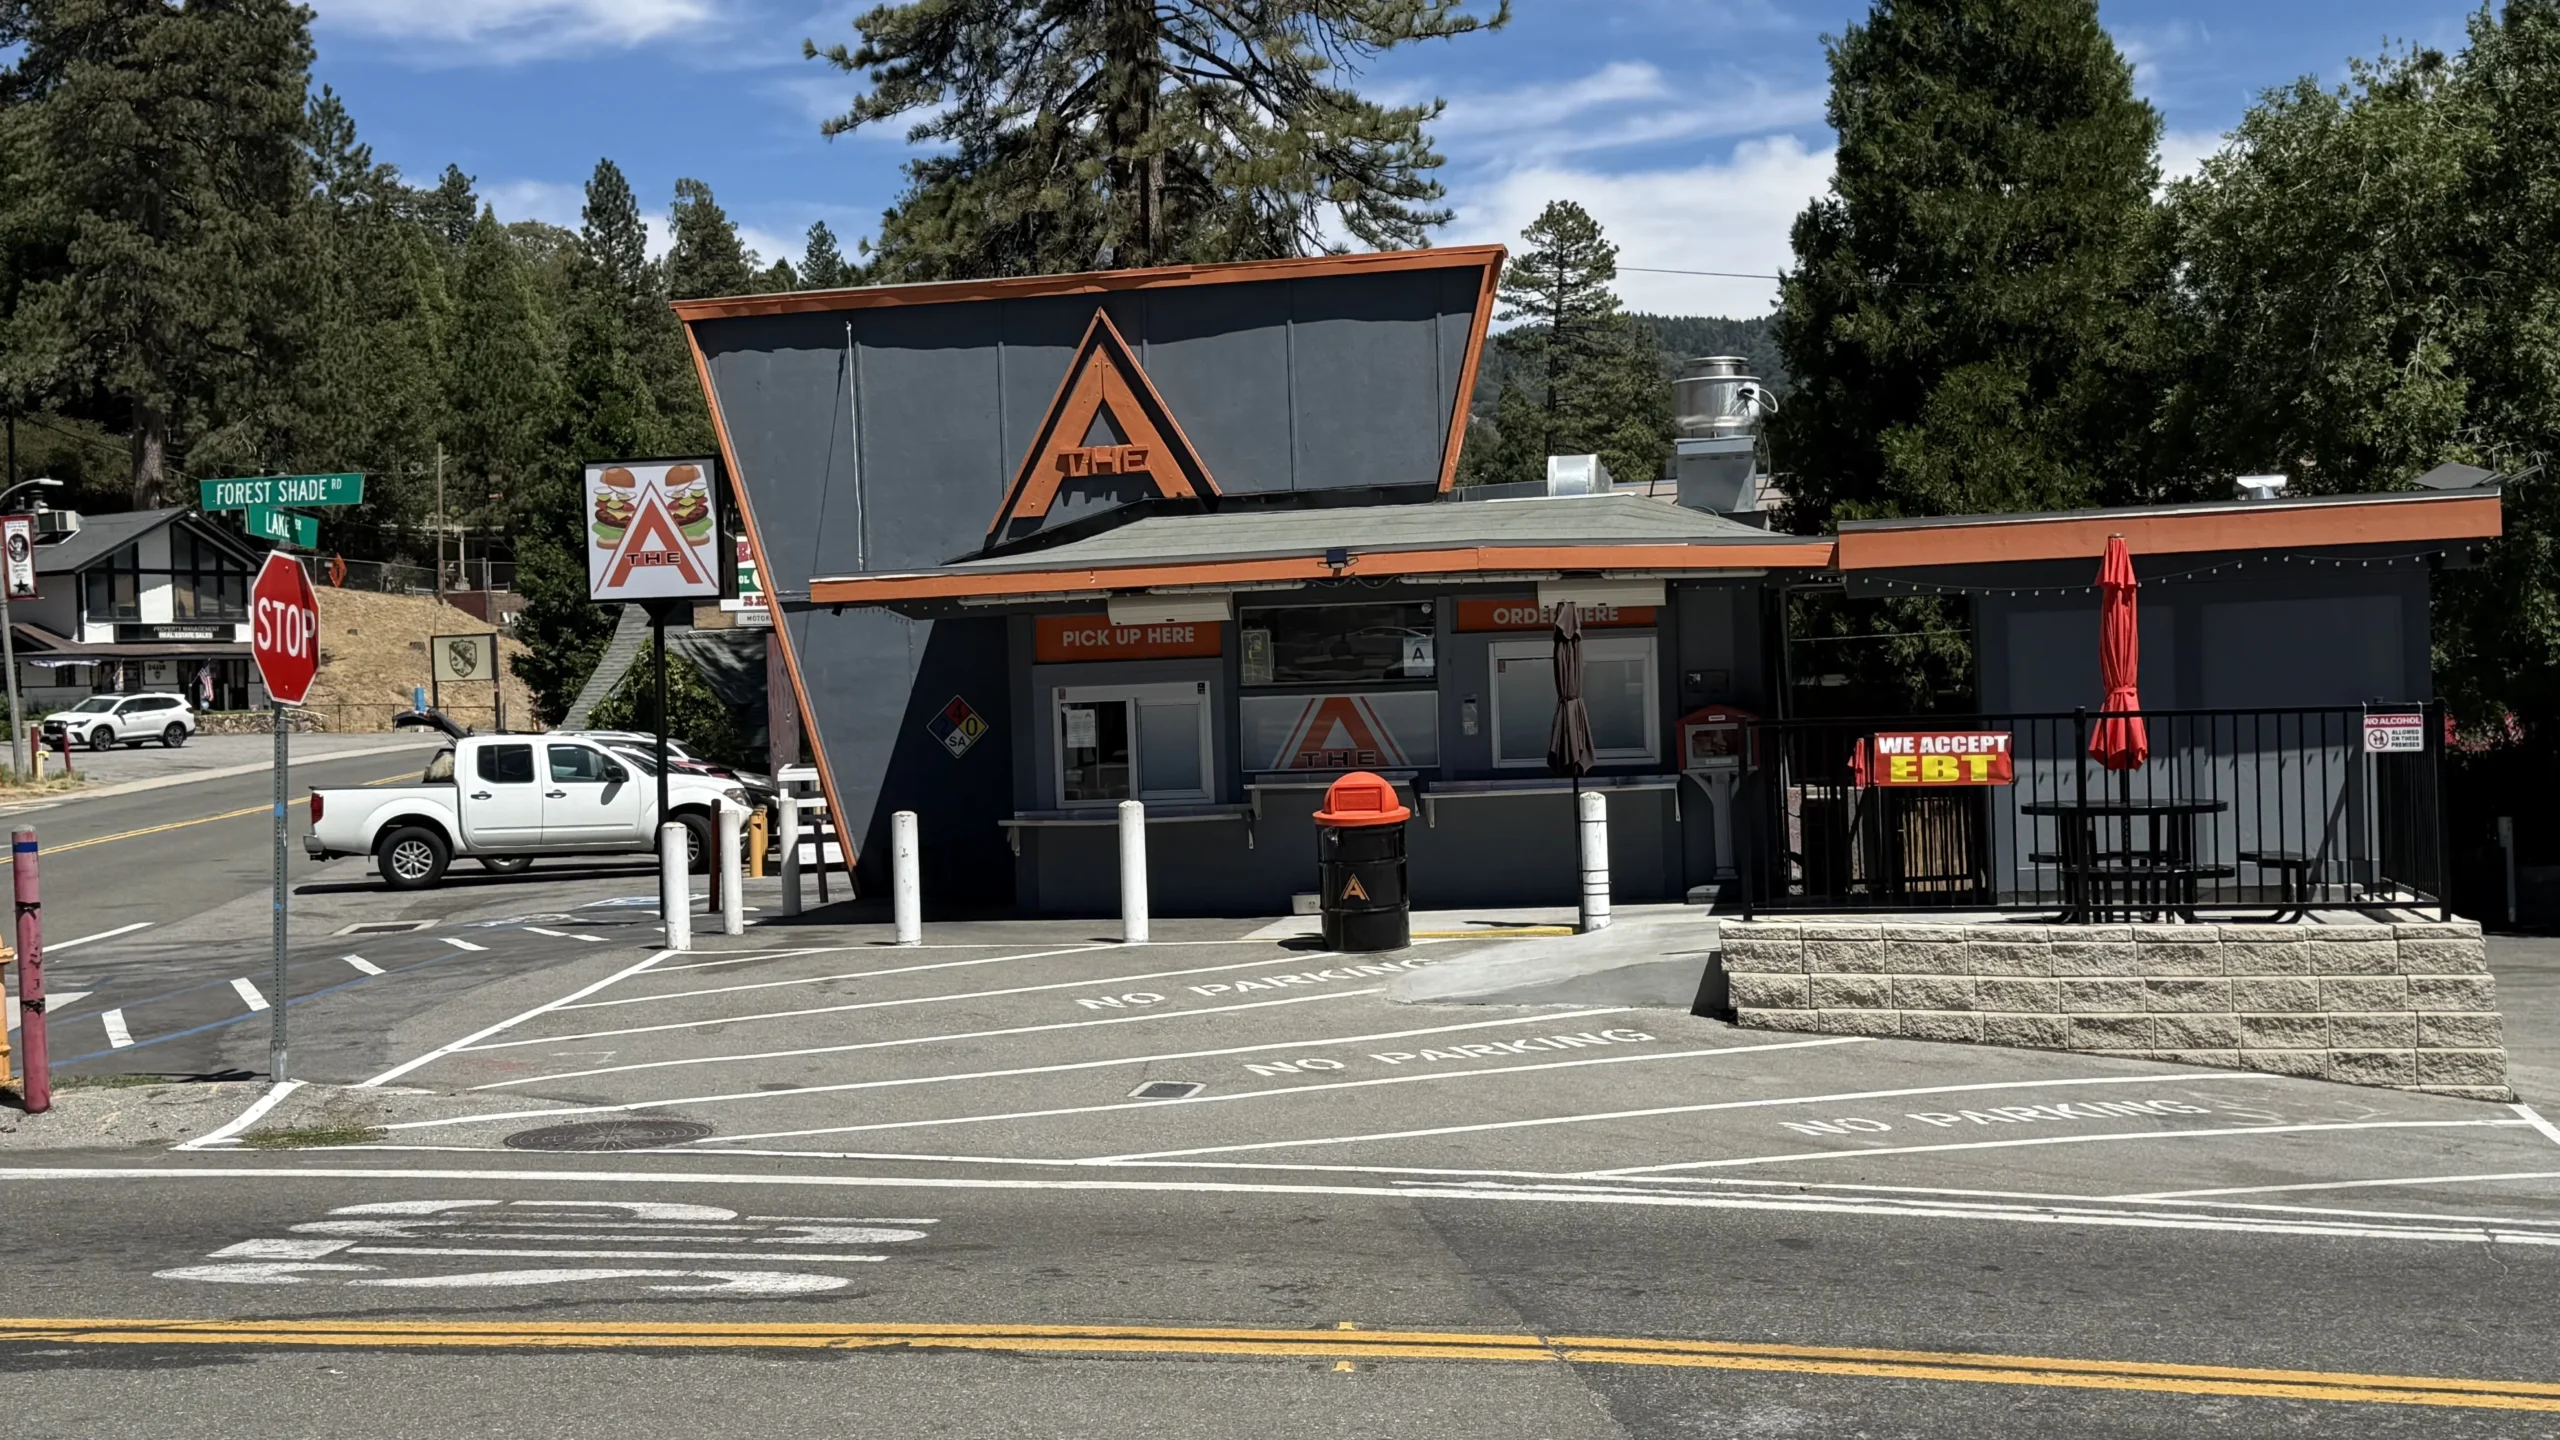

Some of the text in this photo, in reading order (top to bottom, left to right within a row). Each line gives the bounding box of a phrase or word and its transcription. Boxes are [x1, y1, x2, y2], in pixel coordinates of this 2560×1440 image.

[1058, 446, 1150, 477] THE
[216, 478, 342, 505] FOREST SHADE RD
[265, 511, 290, 538] LAKE
[625, 551, 681, 566] THE
[1493, 608, 1557, 625] ORDE
[256, 597, 315, 659] STOP
[1062, 626, 1194, 647] PICK UP HERE
[1412, 647, 1425, 662] A
[951, 703, 962, 719] 4
[2365, 716, 2420, 725] NO ALCOHOL
[966, 718, 978, 736] 0
[949, 736, 966, 747] SA
[1878, 735, 2009, 754] WE ACCEPT
[1300, 750, 1377, 767] THE
[1890, 754, 1997, 783] EBT
[1075, 958, 1439, 1010] NO PARKING
[1244, 1028, 1656, 1077] NO PARKING
[1778, 1099, 2213, 1137] NO PARKING
